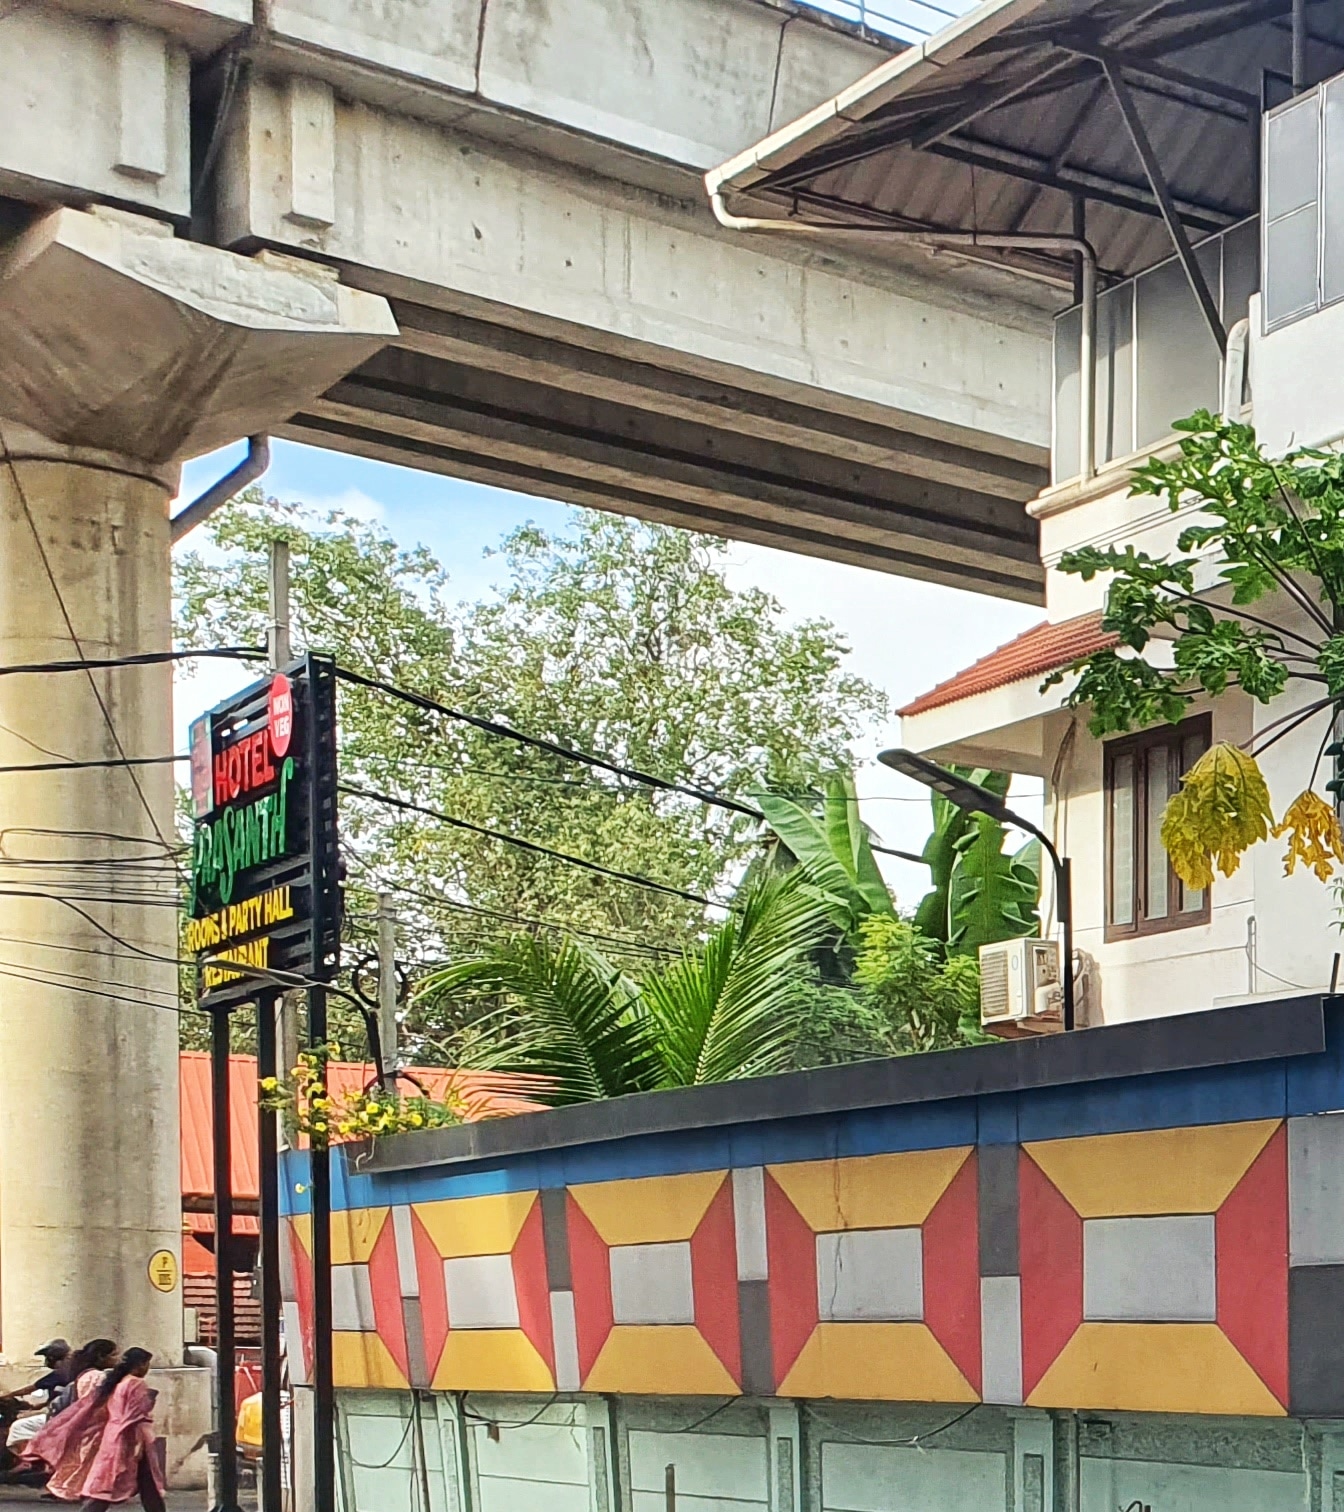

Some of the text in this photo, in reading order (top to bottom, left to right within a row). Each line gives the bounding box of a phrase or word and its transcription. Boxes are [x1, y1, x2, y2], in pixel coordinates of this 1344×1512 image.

[273, 714, 290, 738] VEG
[215, 728, 275, 806] HOTEL
[188, 913, 220, 953] ROOMS
[229, 894, 263, 937] PARTY
[264, 885, 294, 925] HALL
